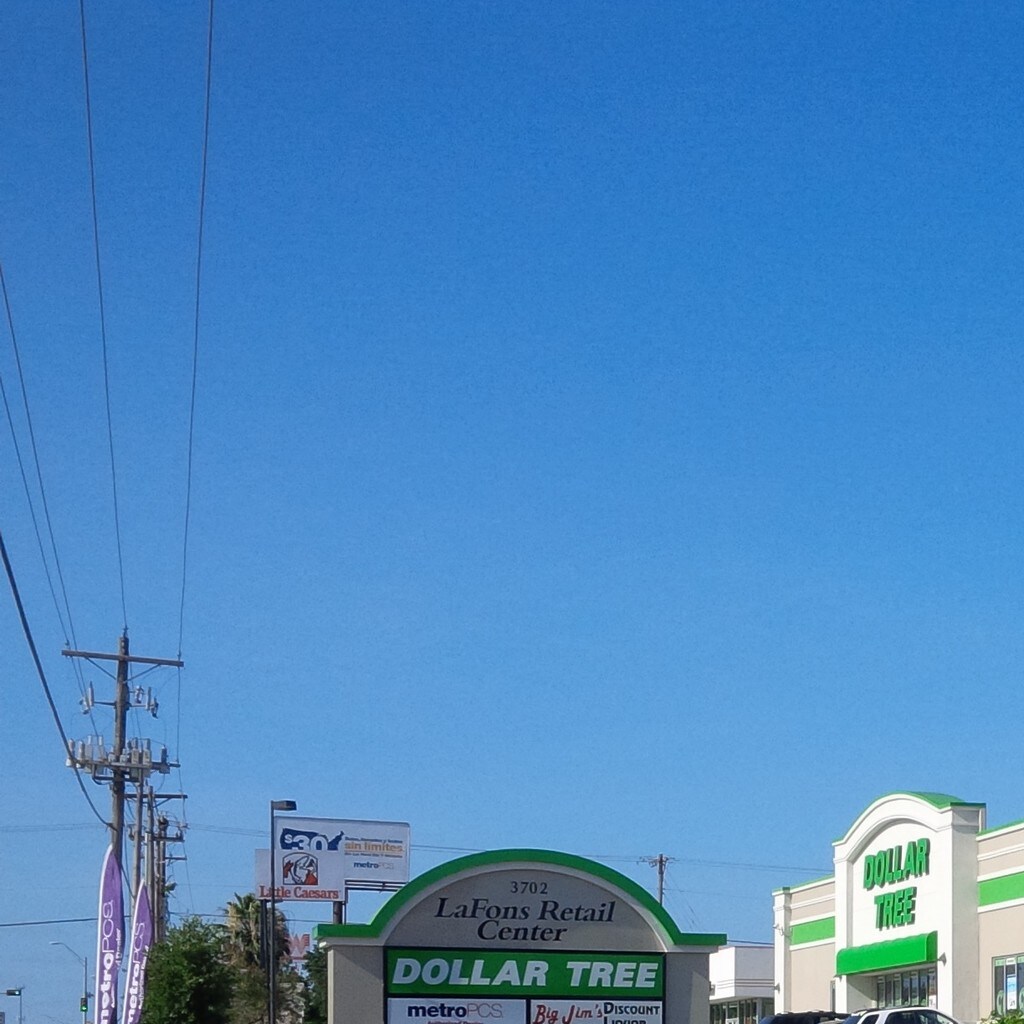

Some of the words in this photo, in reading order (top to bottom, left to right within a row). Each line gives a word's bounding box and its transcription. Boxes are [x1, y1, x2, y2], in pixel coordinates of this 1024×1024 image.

[863, 838, 930, 891] DOLLAR
[294, 886, 339, 899] Caesars
[510, 881, 548, 894] 3702
[434, 898, 530, 921] LaFons
[538, 901, 615, 923] Retail
[874, 886, 917, 931] TREE
[477, 920, 568, 942] Center
[392, 958, 549, 986] DOLLAR
[566, 961, 659, 988] TREE
[407, 1003, 503, 1018] metroPCS
[532, 1004, 559, 1024] Big
[562, 1004, 603, 1024] Jim's
[603, 1002, 660, 1016] DISCOUNT
